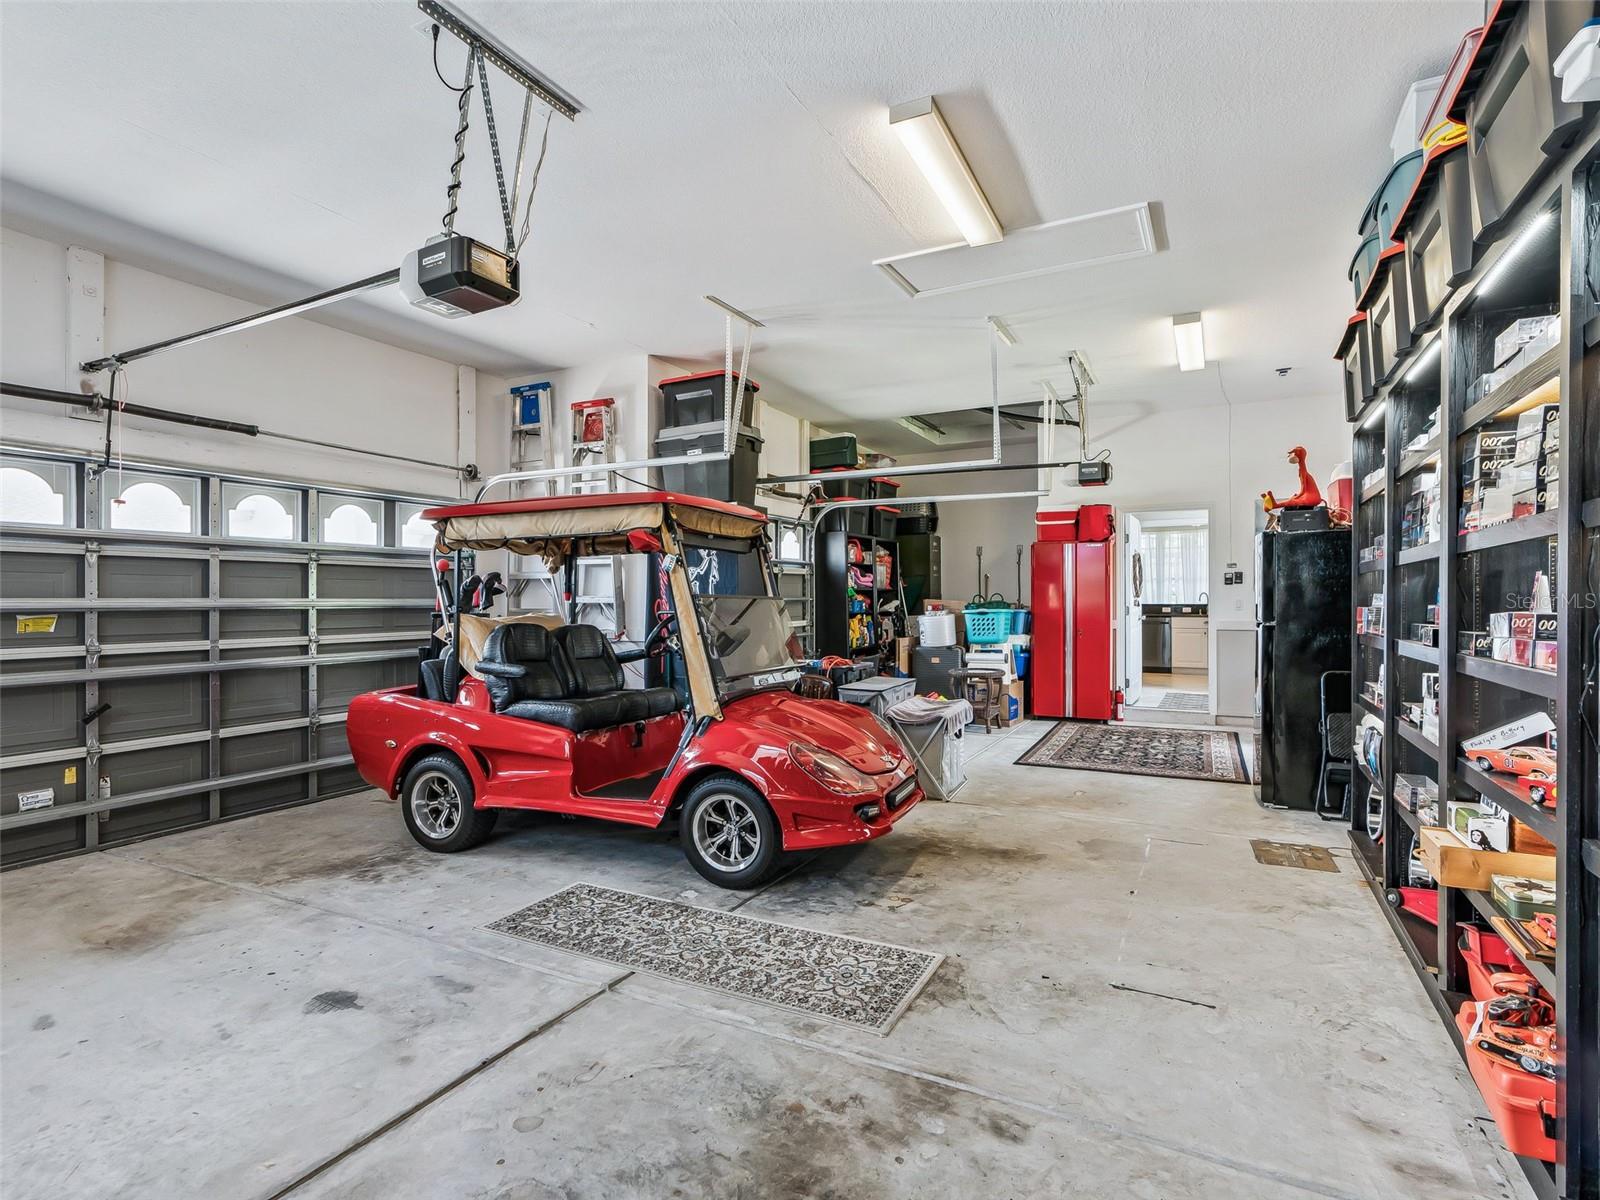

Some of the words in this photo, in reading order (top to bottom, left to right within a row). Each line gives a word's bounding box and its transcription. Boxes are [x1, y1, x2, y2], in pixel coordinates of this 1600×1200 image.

[1481, 436, 1504, 447] 007
[1481, 460, 1504, 470] 007
[1511, 617, 1534, 628] 007
[1503, 757, 1515, 769] 01
